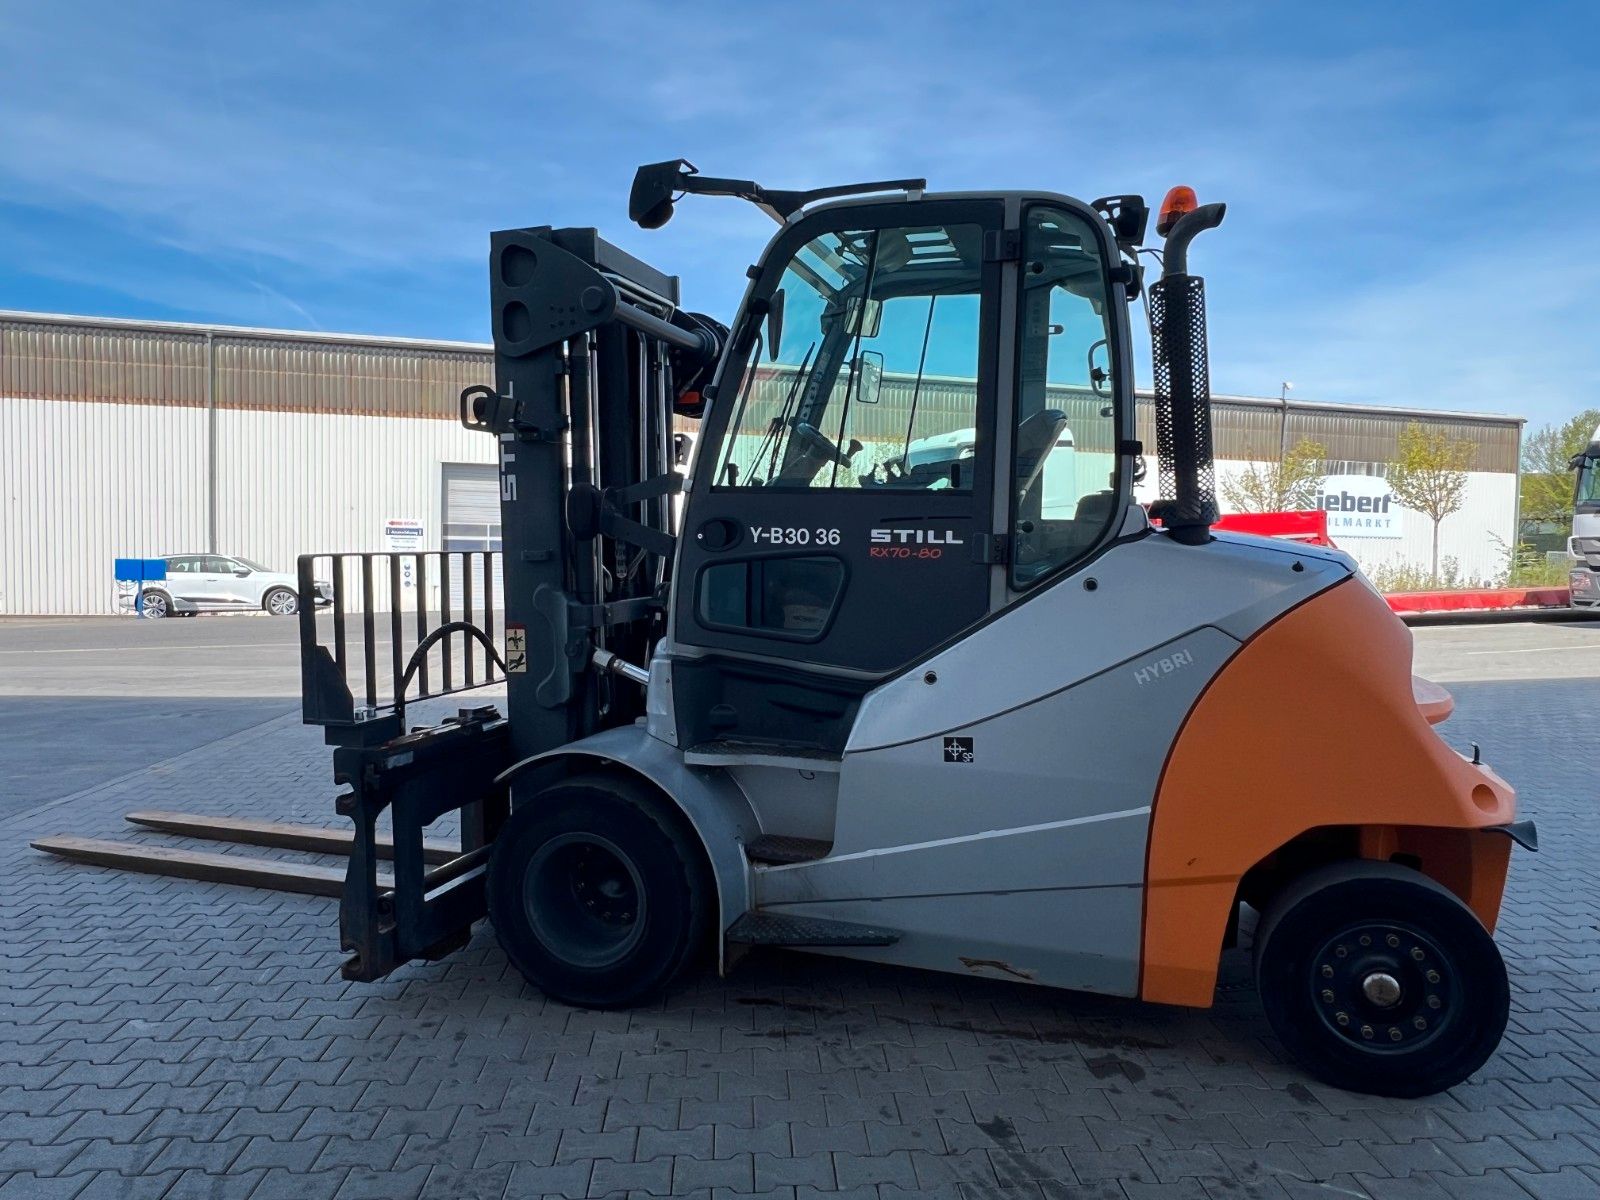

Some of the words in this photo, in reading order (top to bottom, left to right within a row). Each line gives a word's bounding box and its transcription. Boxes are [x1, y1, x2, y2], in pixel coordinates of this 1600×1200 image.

[500, 380, 517, 501] STIL
[1328, 517, 1391, 528] ILMARKT
[750, 526, 810, 545] Y-B30
[815, 528, 841, 545] 36
[870, 529, 964, 544] STILL
[870, 547, 942, 559] RX70-80
